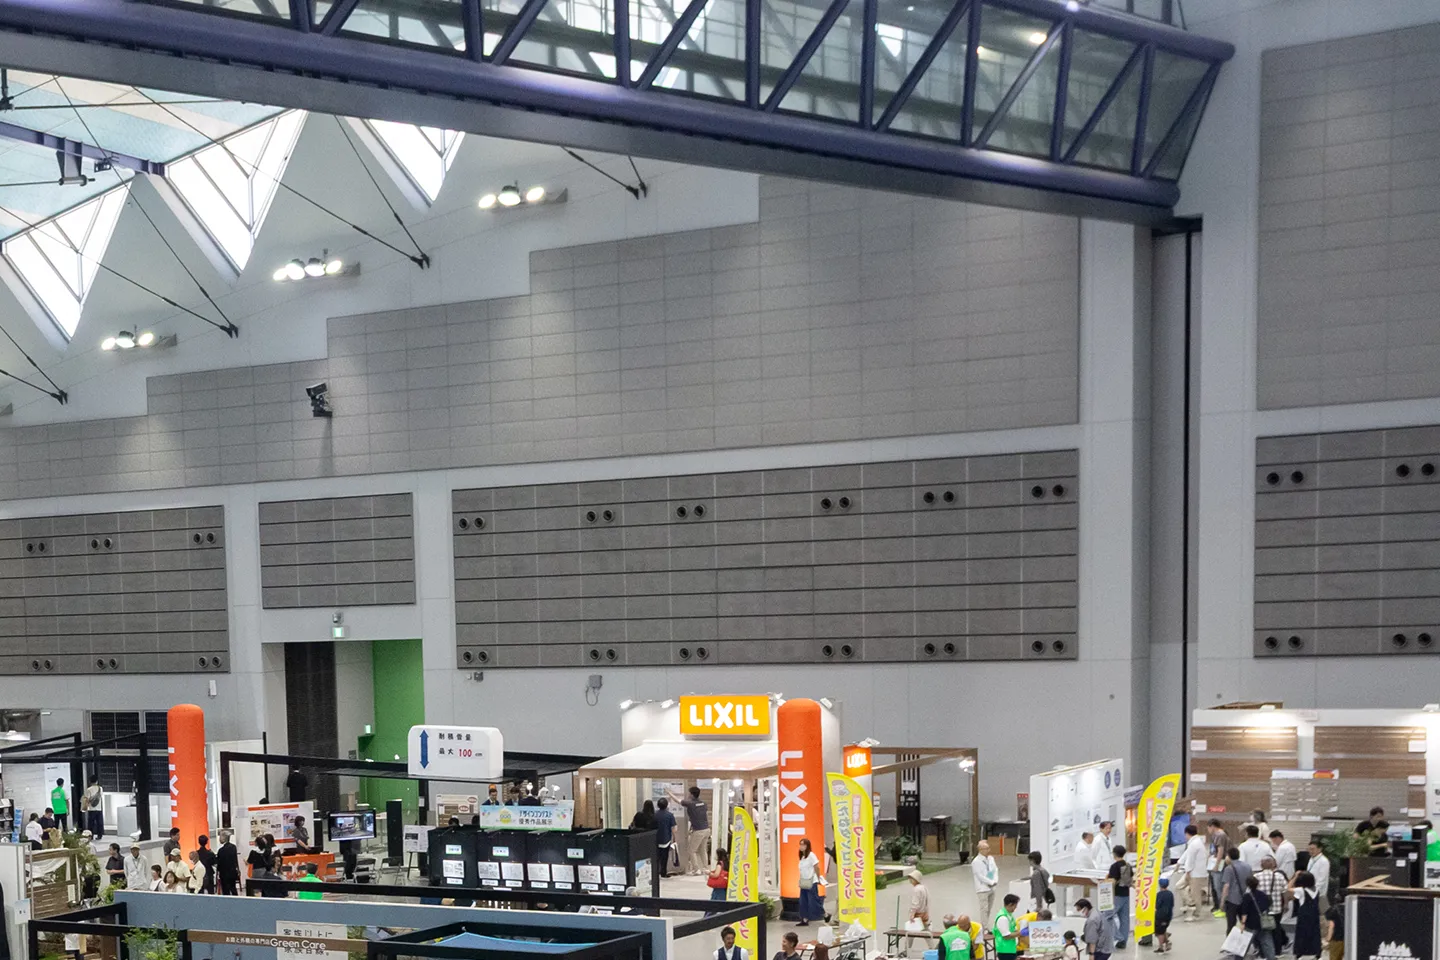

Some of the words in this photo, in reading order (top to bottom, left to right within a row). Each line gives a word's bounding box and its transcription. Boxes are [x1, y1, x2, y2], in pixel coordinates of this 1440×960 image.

[689, 702, 759, 729] LIXIL
[458, 749, 473, 758] 100
[846, 752, 868, 769] LIXIL
[779, 750, 808, 844] LIXIL
[270, 937, 300, 949] Green
[301, 939, 327, 951] Care
